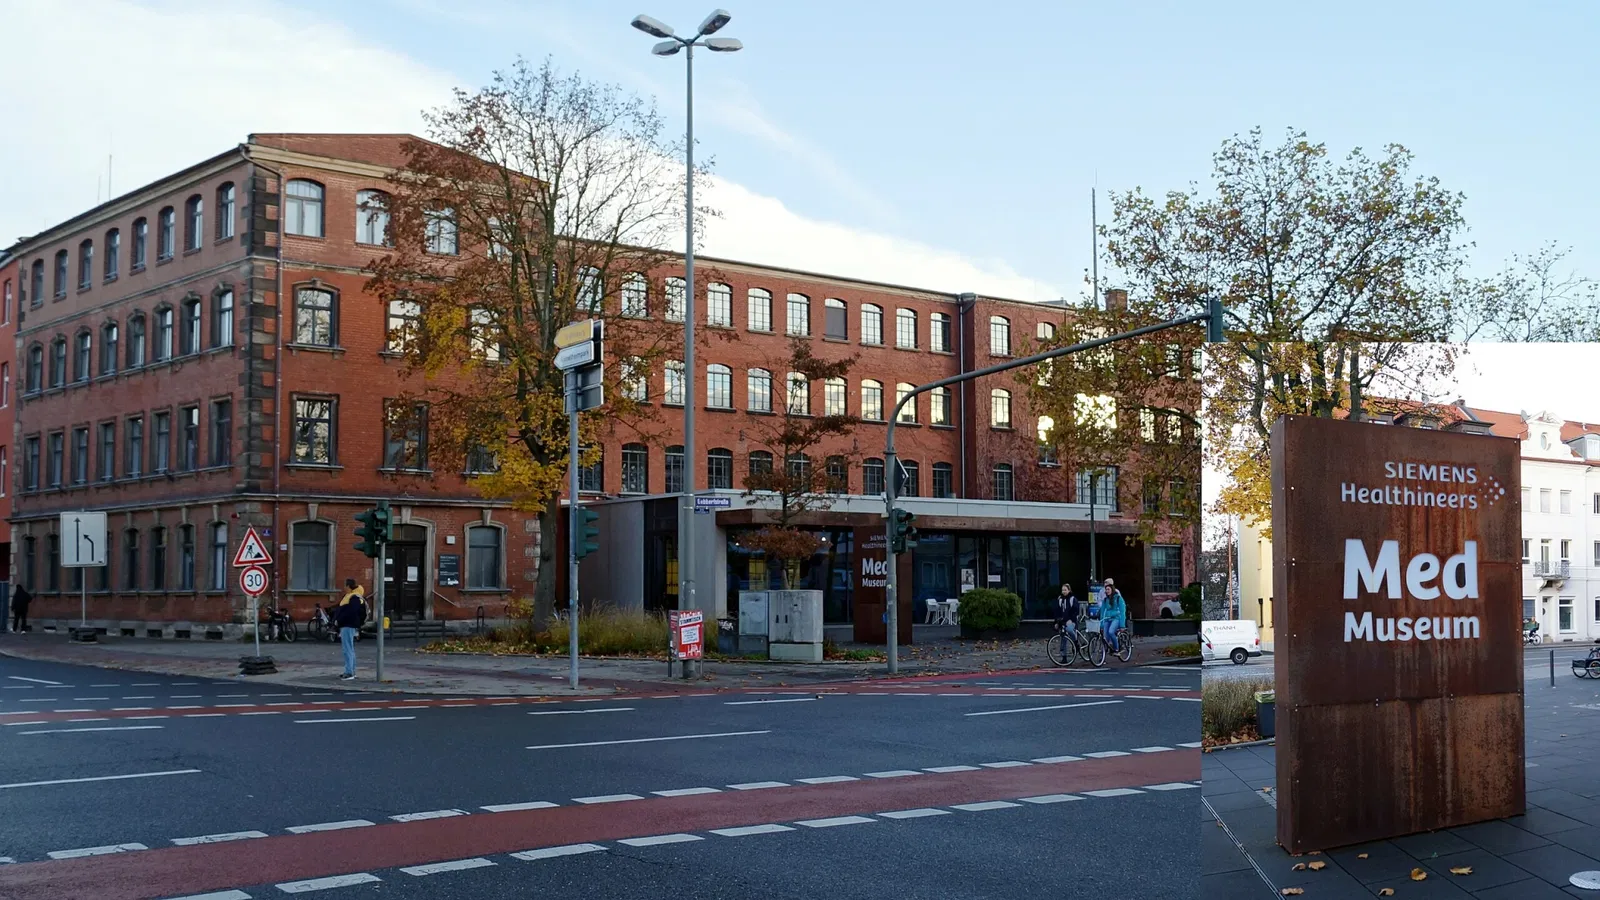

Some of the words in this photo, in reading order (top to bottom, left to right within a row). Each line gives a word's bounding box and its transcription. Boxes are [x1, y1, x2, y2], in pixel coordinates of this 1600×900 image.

[1384, 461, 1477, 484] SIEMENS
[1341, 482, 1478, 509] Healthineers
[246, 573, 262, 587] 30
[1343, 538, 1479, 600] Med
[1344, 611, 1480, 642] Museum
